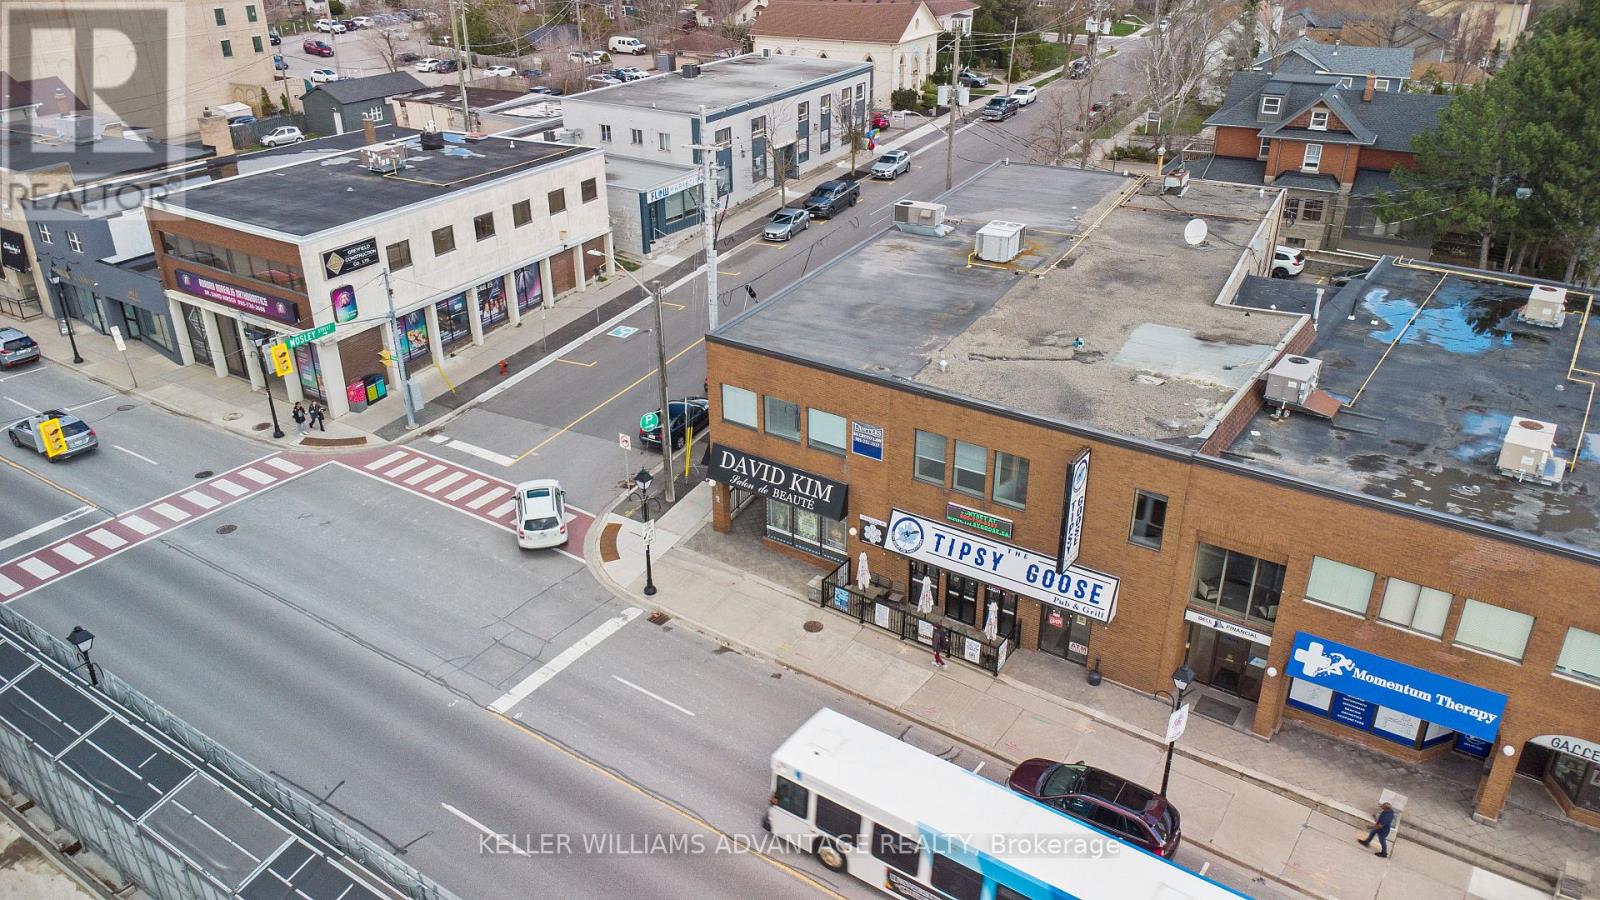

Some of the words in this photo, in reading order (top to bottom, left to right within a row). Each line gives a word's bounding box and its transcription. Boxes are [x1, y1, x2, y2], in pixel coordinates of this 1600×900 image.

[290, 330, 316, 347] MOSLEY
[645, 415, 654, 425] P
[719, 450, 786, 486] DAVID
[788, 472, 834, 503] KIM
[729, 474, 754, 491] Salon
[757, 484, 769, 494] de
[772, 488, 815, 511] BEAUTÉ
[1007, 548, 1029, 560] THE
[933, 532, 1004, 572] TIPSY
[1026, 563, 1103, 605] GOOSE
[1053, 596, 1070, 607] Pub
[1082, 606, 1104, 619] Grill
[1225, 625, 1258, 640] FINANCIAL
[1352, 667, 1432, 703] Momentum
[1436, 693, 1498, 724] Therapy
